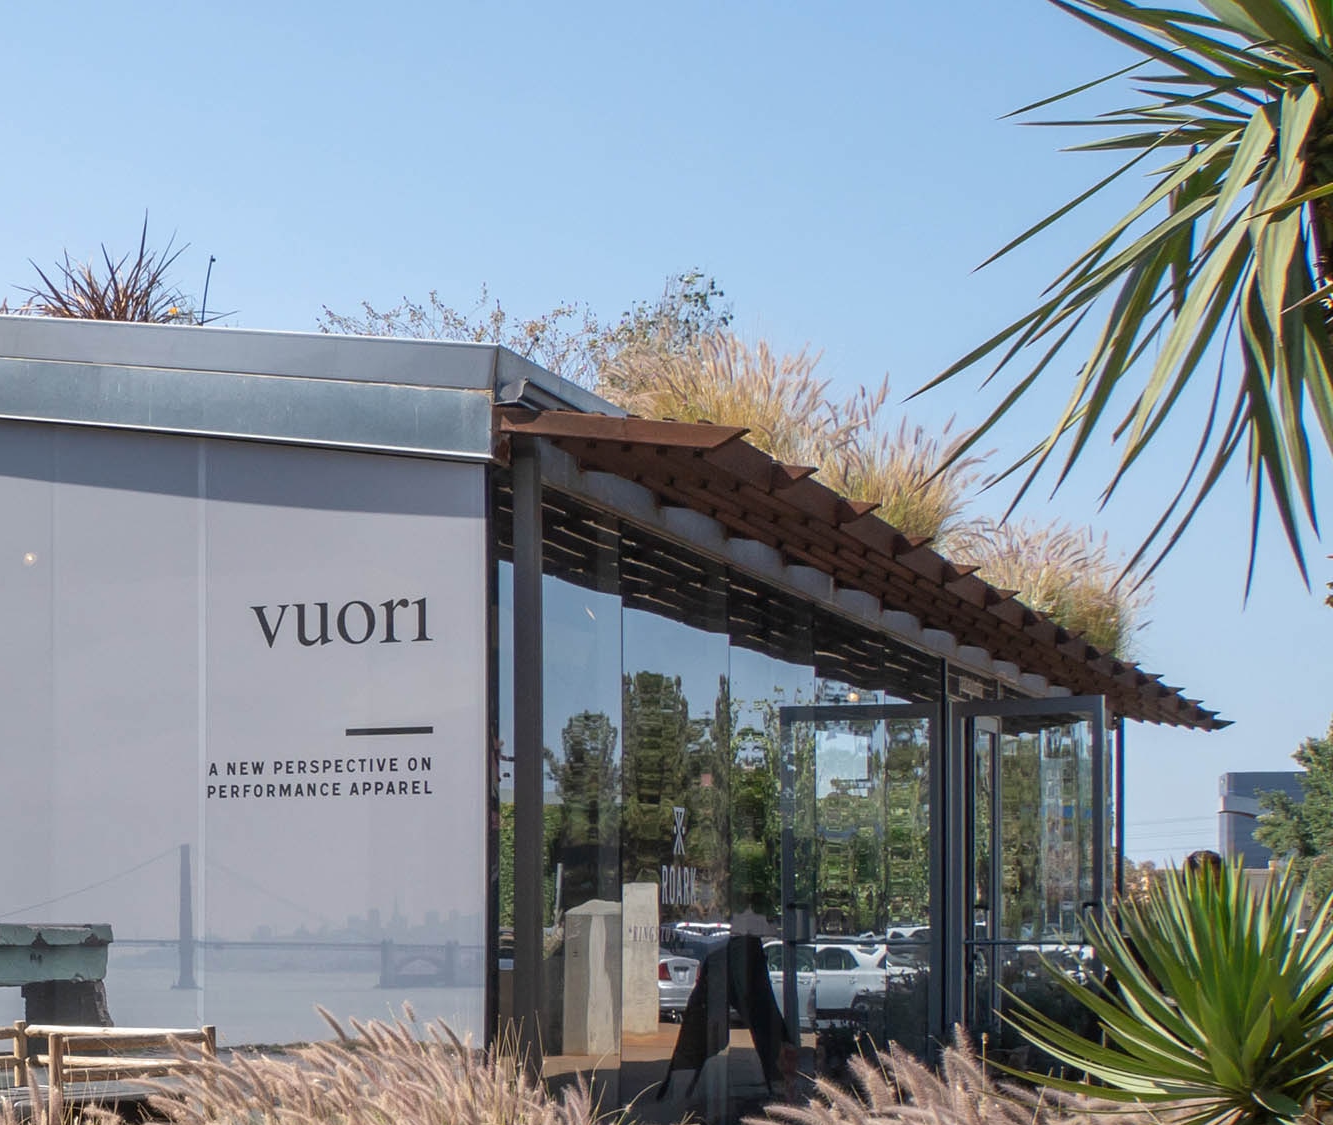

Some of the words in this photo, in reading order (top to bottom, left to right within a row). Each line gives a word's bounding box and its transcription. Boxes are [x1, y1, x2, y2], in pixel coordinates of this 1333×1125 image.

[250, 597, 433, 649] vuori
[208, 762, 218, 776] A
[226, 761, 264, 776] NEW
[273, 757, 399, 775] PERSPECTIVE
[407, 757, 432, 772] ON
[207, 782, 341, 799] PERFORMANCE
[349, 780, 433, 796] APPAREL
[662, 865, 697, 905] ROARK
